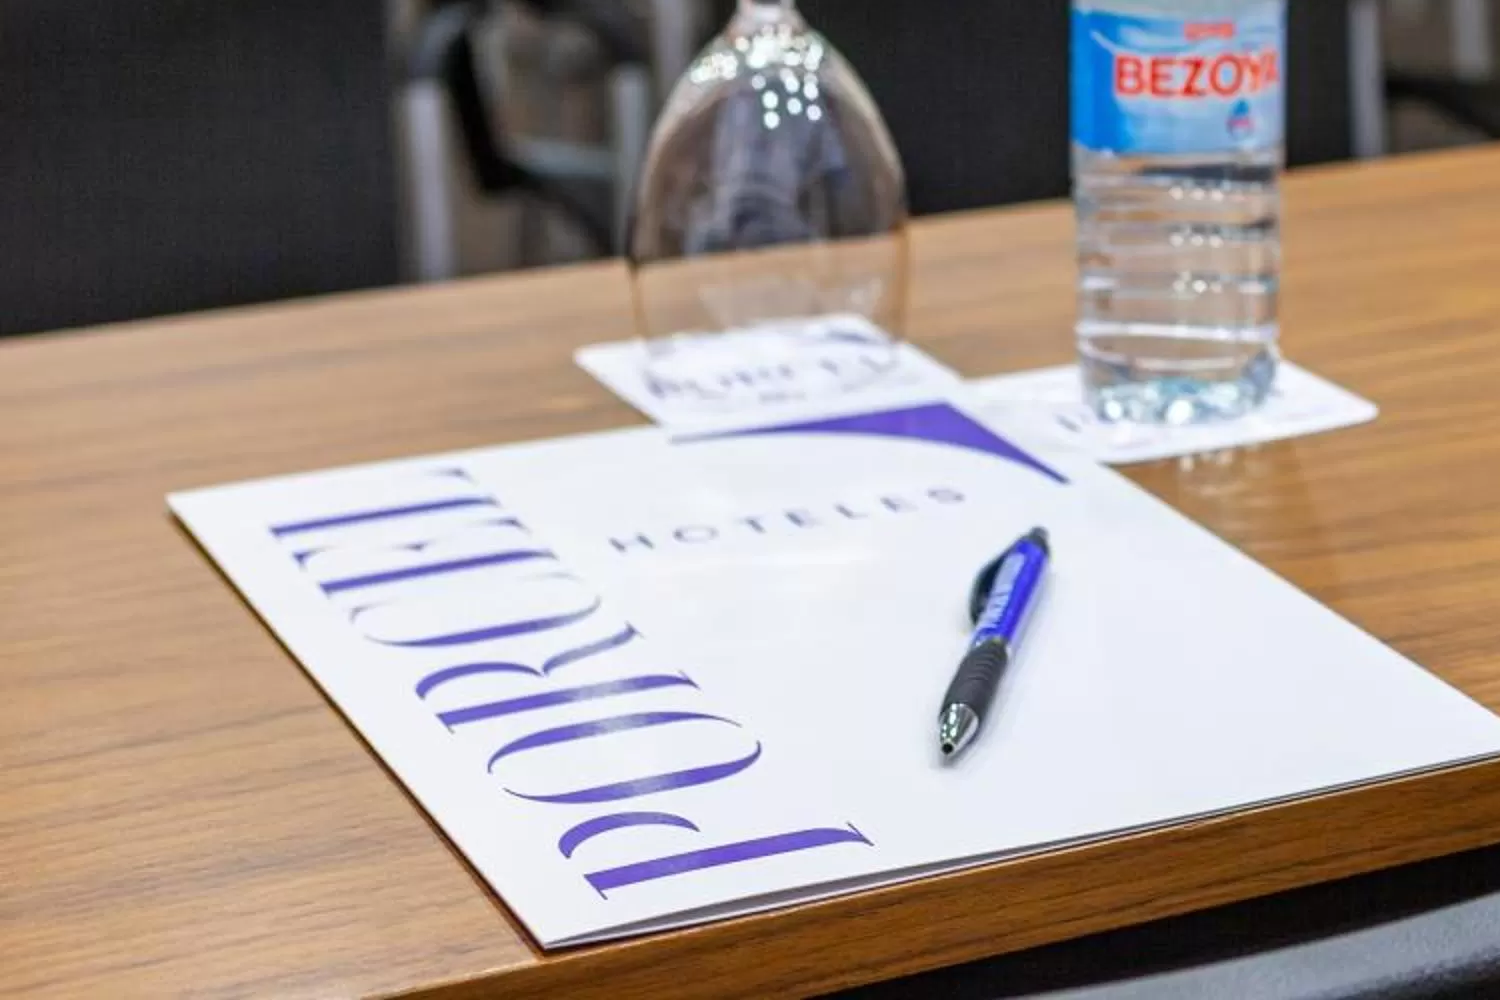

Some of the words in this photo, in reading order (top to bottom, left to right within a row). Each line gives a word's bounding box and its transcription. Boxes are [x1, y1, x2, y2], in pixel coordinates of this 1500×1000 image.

[1113, 46, 1279, 98] BEZOYA
[608, 485, 967, 553] HOTELES
[269, 467, 875, 901] PORCEL
